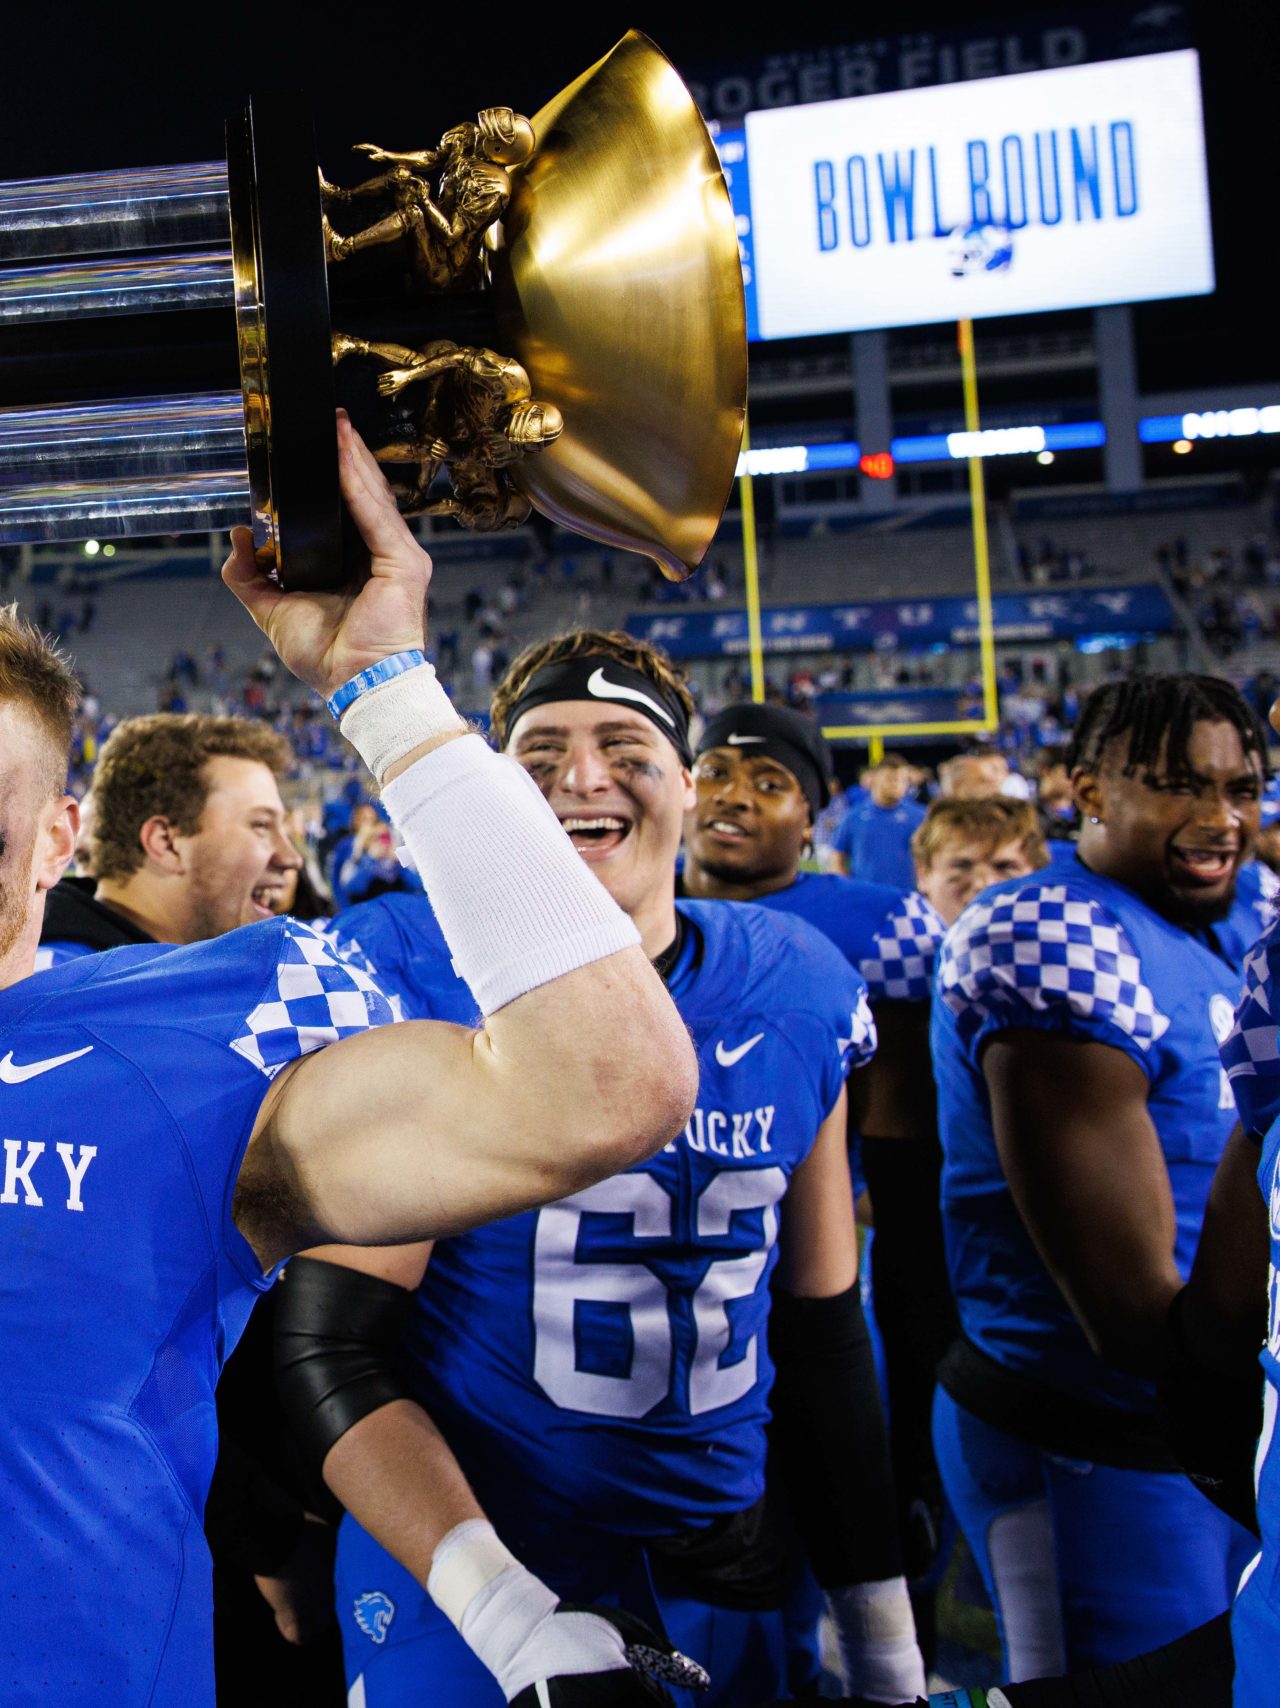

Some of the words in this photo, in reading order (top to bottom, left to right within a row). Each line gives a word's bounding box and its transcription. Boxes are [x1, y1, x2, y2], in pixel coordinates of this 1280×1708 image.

[898, 27, 1087, 88] FIELD
[814, 145, 954, 252] BOWL
[967, 121, 1137, 229] BOUND
[533, 1166, 789, 1419] 62
